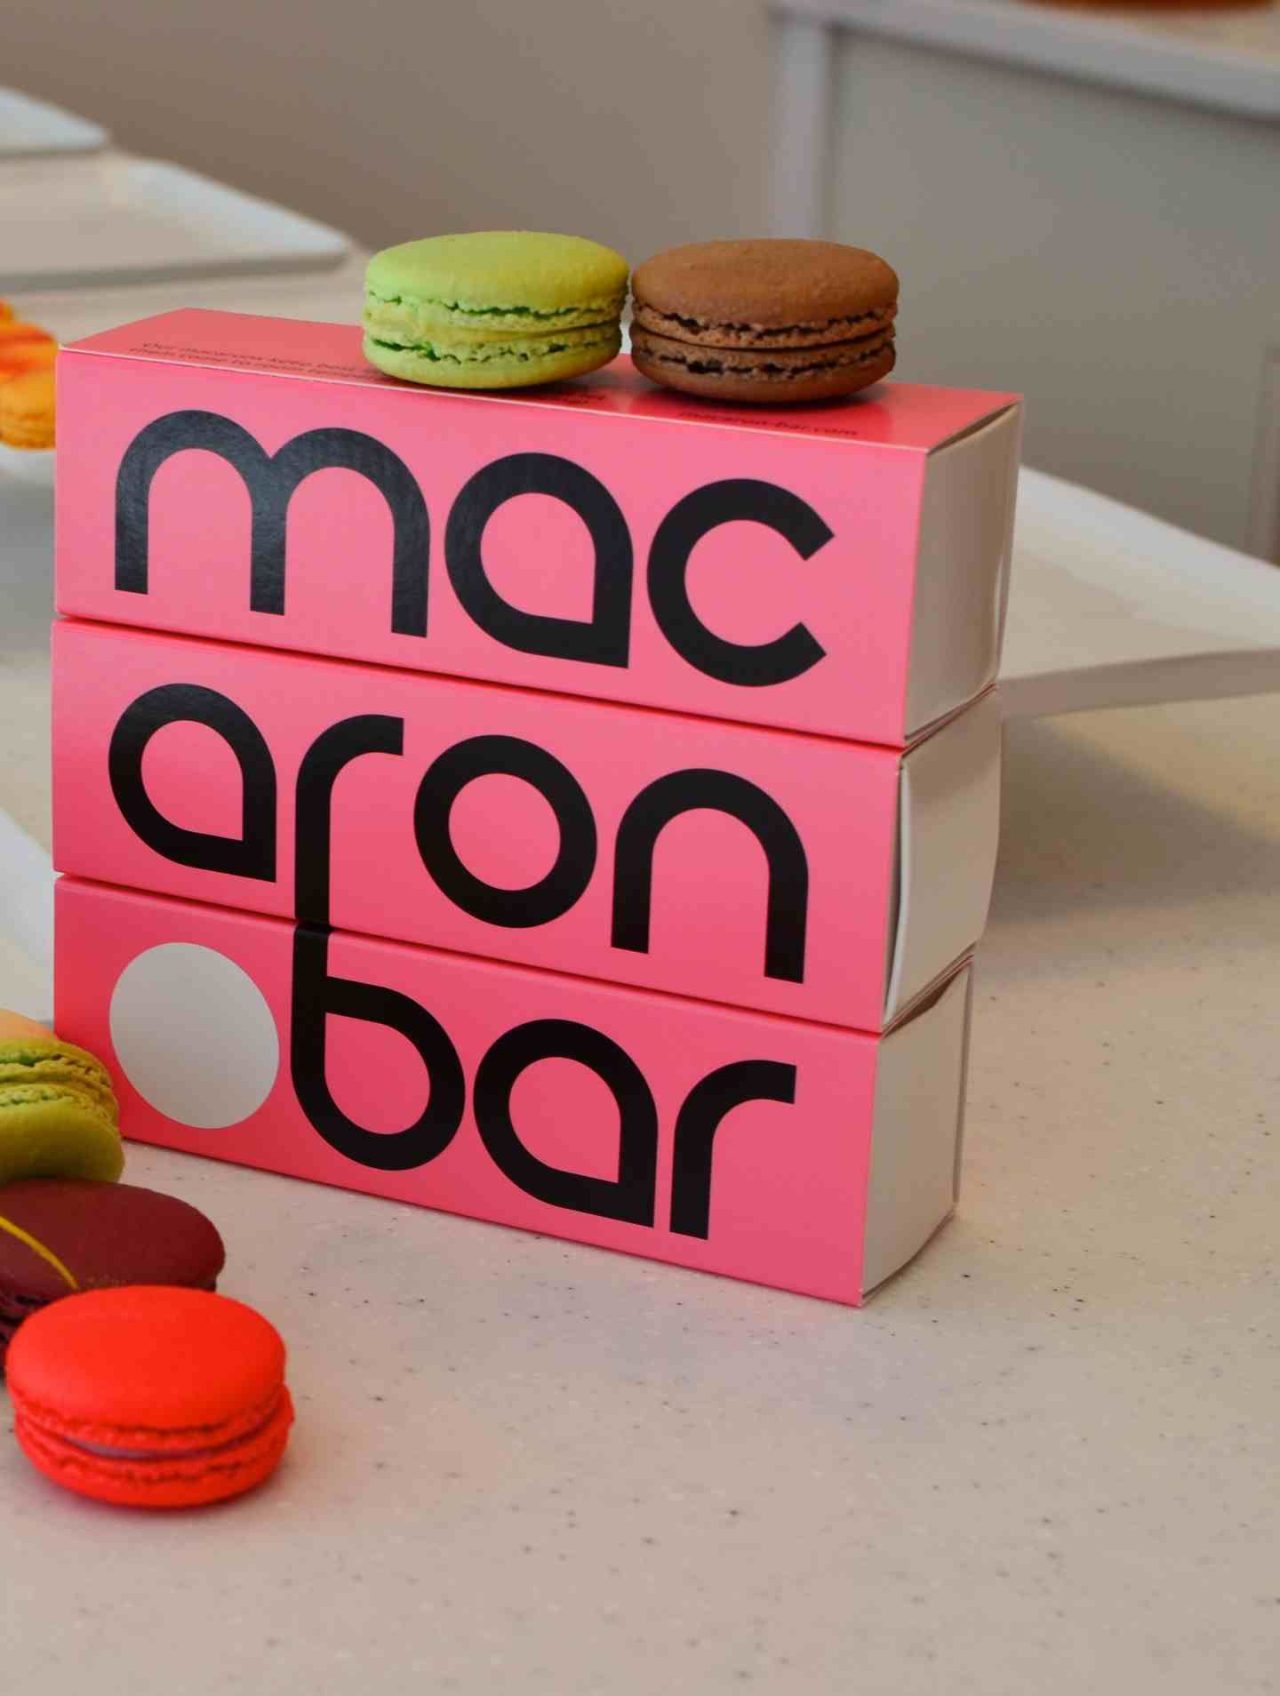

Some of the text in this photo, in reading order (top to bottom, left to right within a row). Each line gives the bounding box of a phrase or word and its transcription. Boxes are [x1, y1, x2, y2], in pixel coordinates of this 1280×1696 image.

[114, 409, 834, 687] mac
[108, 683, 809, 984] aron
[290, 926, 797, 1240] bar
